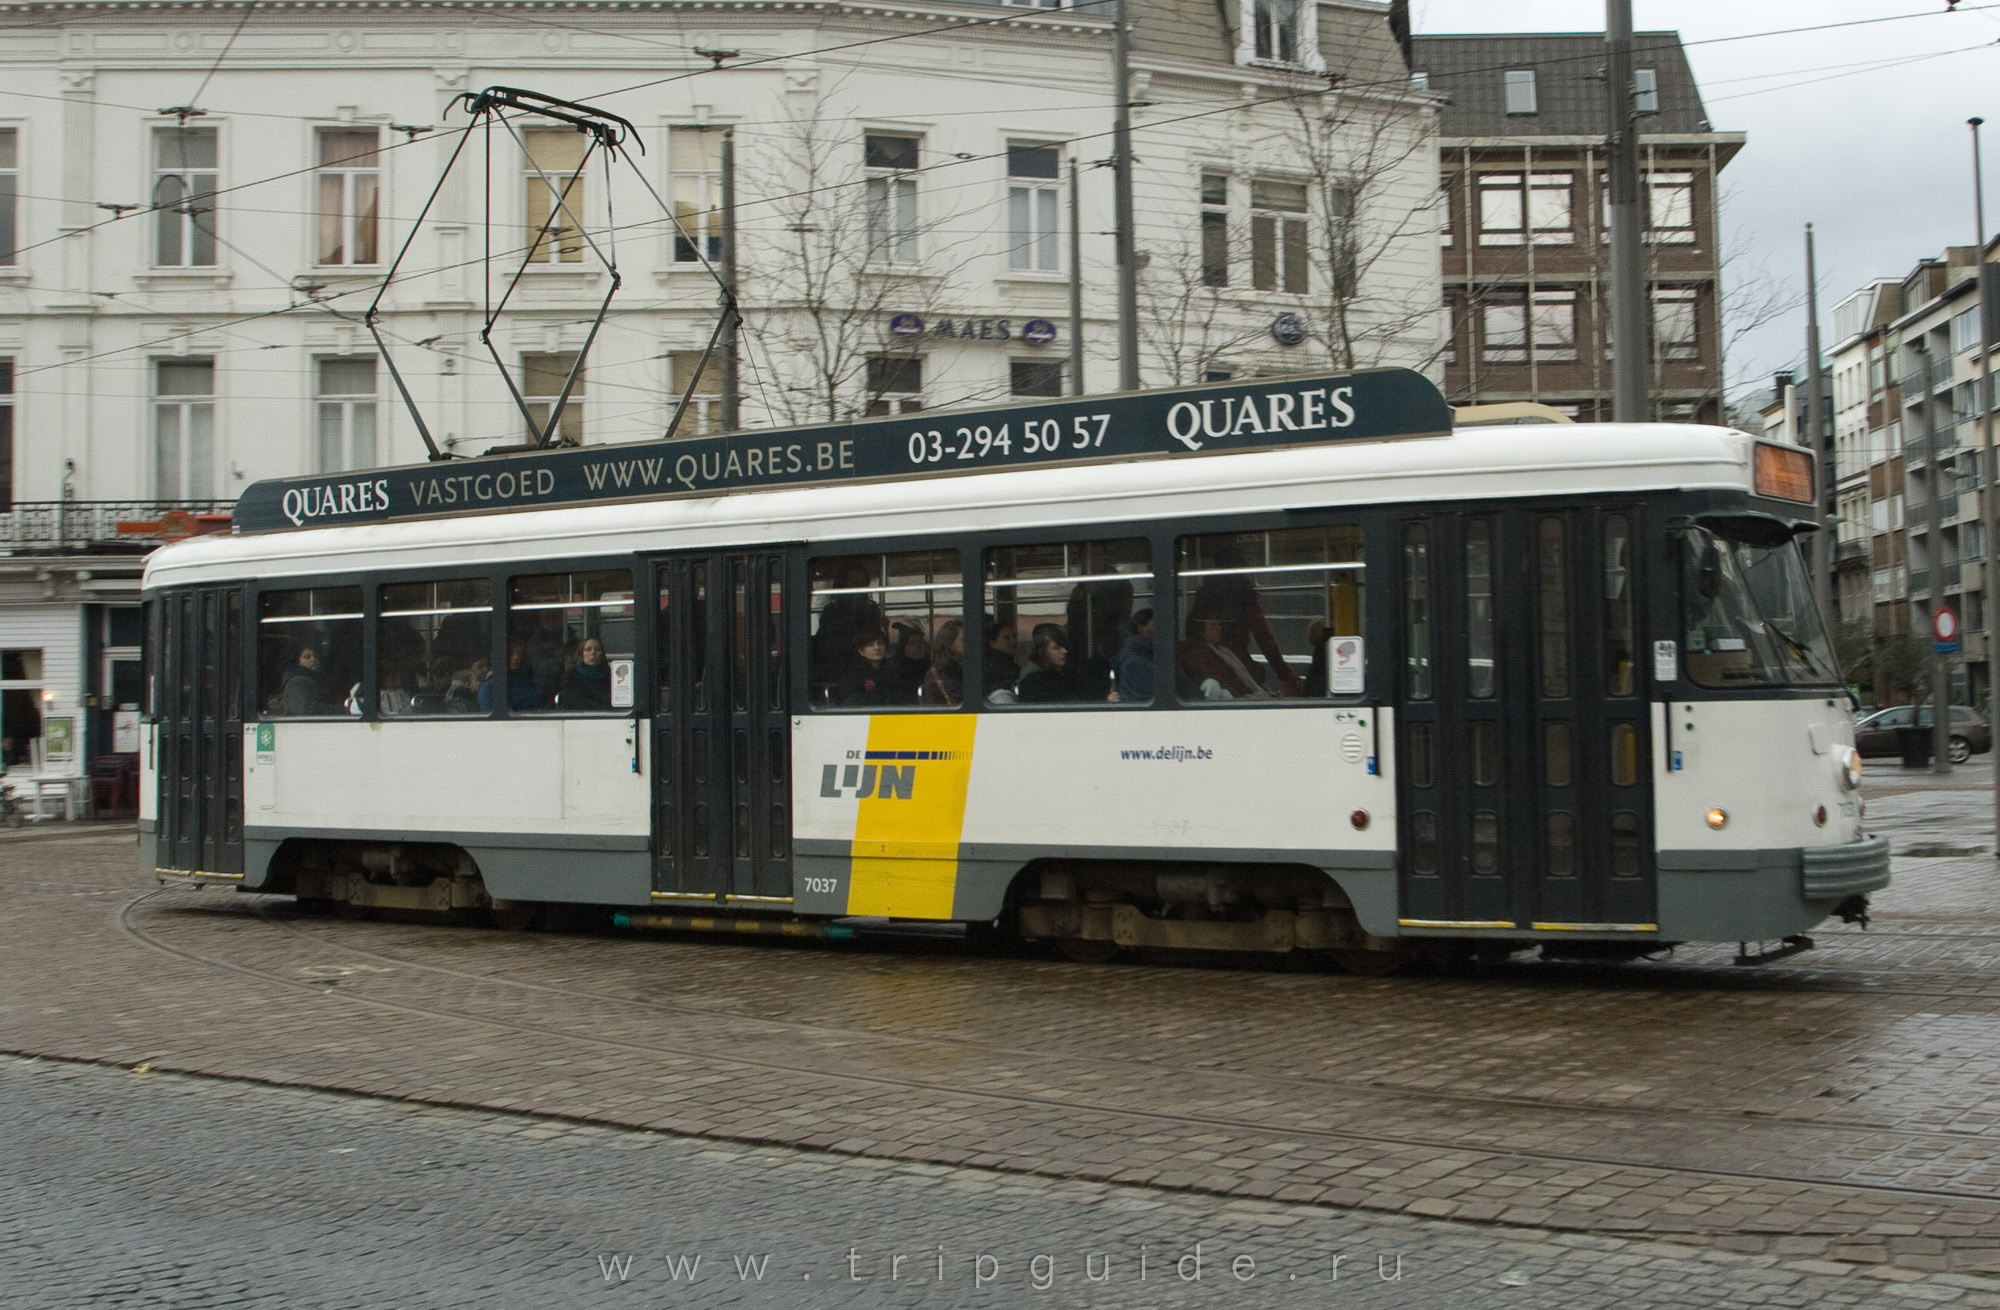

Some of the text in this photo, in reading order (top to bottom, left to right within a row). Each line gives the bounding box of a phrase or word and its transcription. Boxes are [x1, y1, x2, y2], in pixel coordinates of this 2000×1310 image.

[934, 319, 1011, 340] MAES
[282, 386, 1356, 527] QUARES VASTGOED WWW.QUARES.BE 03-294 50 57 QUARES
[846, 750, 861, 760] DE
[1120, 745, 1213, 762] www.delijn.be
[820, 764, 916, 800] LIJN
[804, 877, 837, 893] 7037
